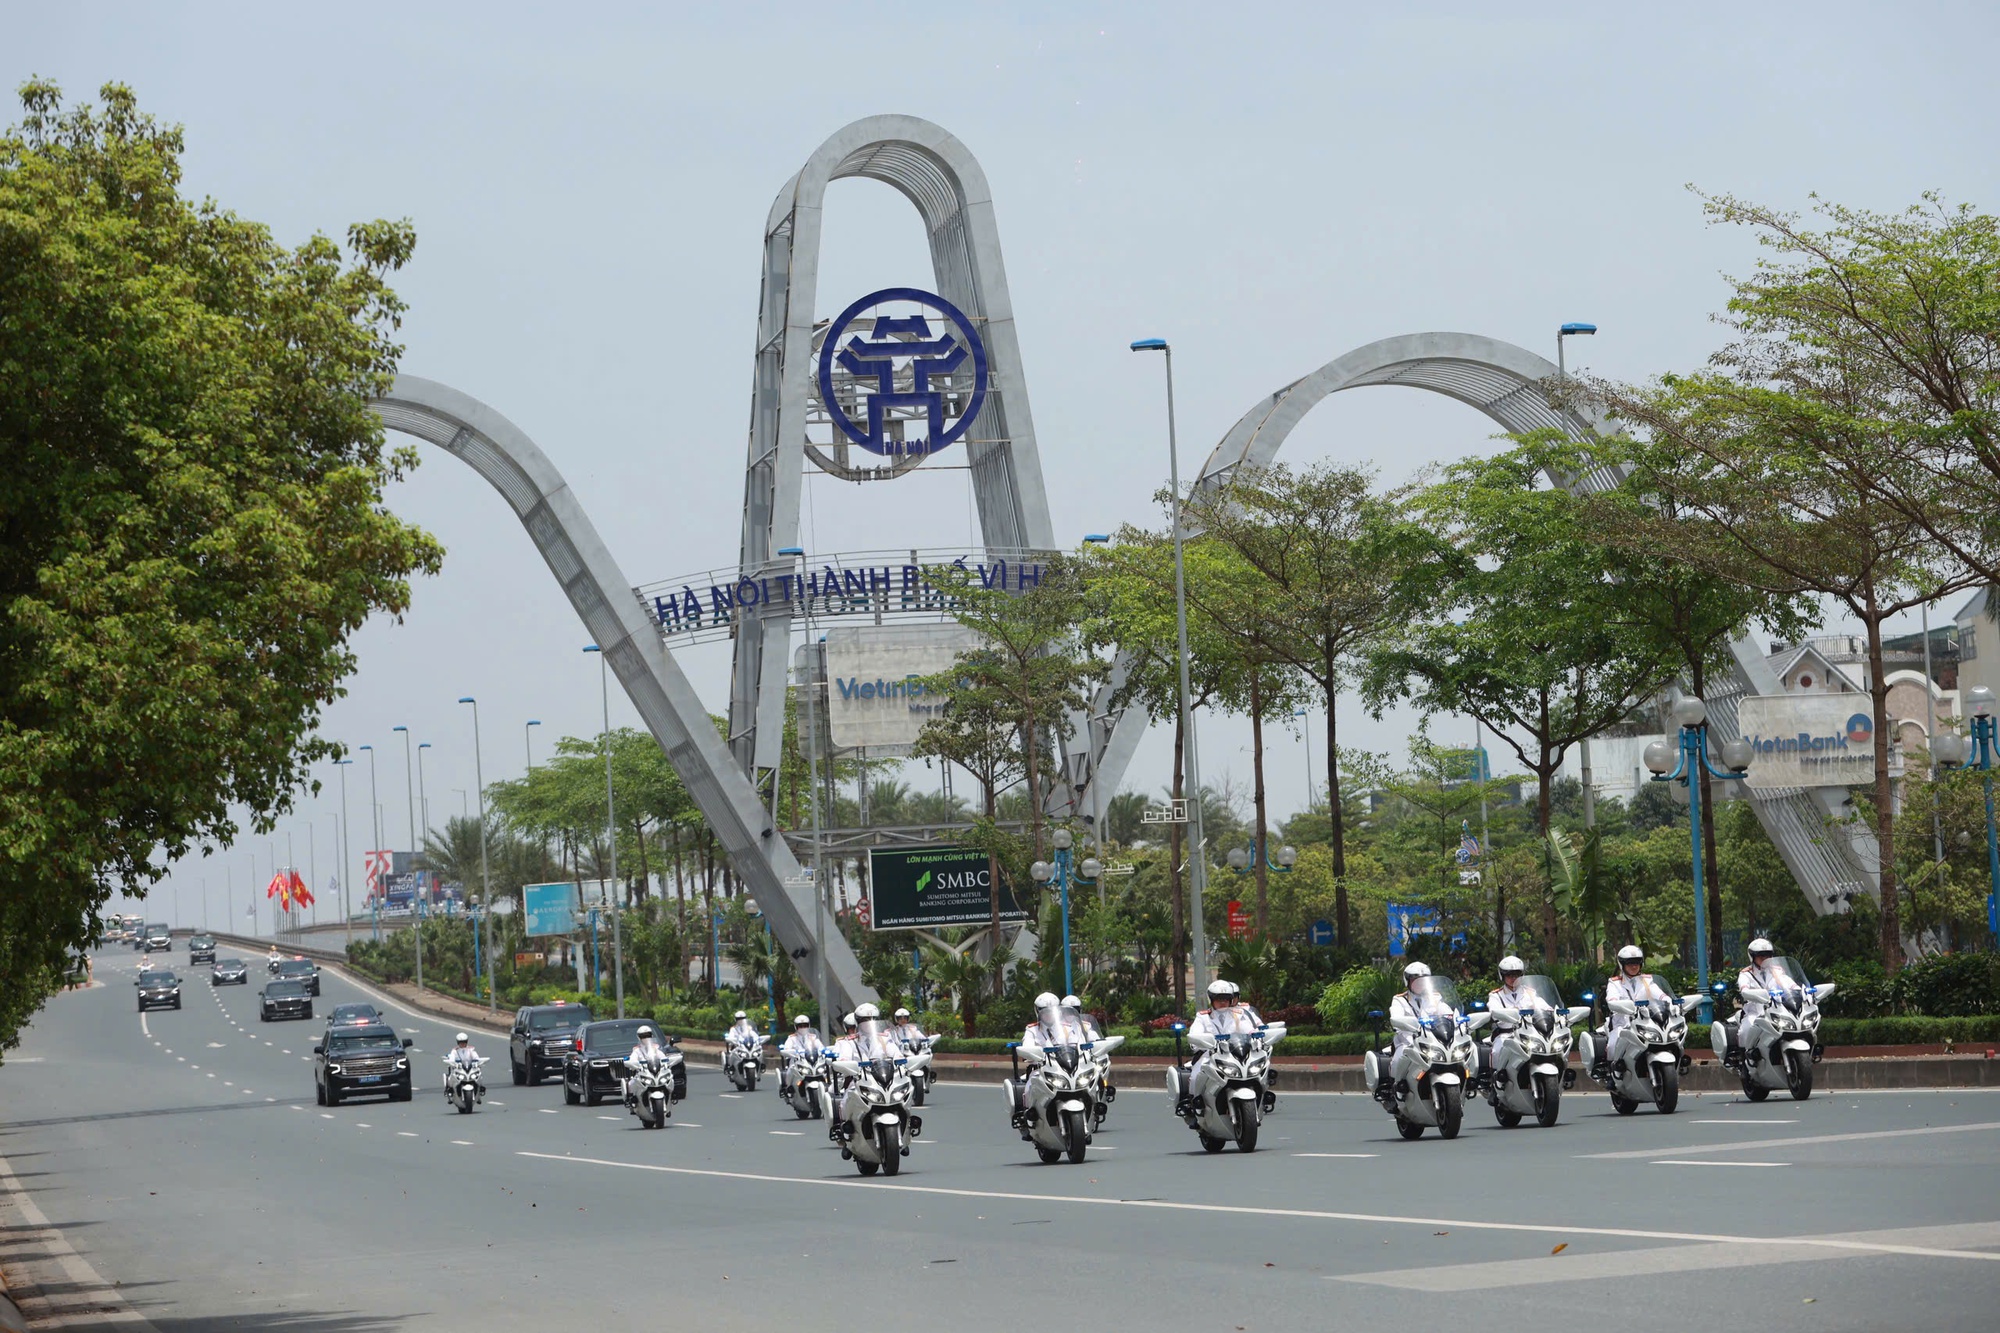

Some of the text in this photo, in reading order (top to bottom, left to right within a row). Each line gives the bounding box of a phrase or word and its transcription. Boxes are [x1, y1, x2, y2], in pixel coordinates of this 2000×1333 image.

[655, 585, 704, 624] HÀ
[711, 575, 770, 613] NỘI
[775, 565, 891, 602] THÀNH
[977, 558, 1007, 590] VÌ
[1744, 731, 1849, 754] VietinBank
[906, 856, 921, 864] LỚN
[922, 856, 943, 864] MẠNH
[944, 852, 963, 862] CÙNG
[965, 852, 979, 862] VIỆT
[937, 870, 990, 890] SMBC
[919, 897, 990, 907] BANKING CORPORATION
[927, 892, 960, 900] SUMITOMO
[915, 914, 945, 923] SUMITOMO
[946, 913, 965, 921] MITSUI
[965, 912, 990, 920] BANKING
